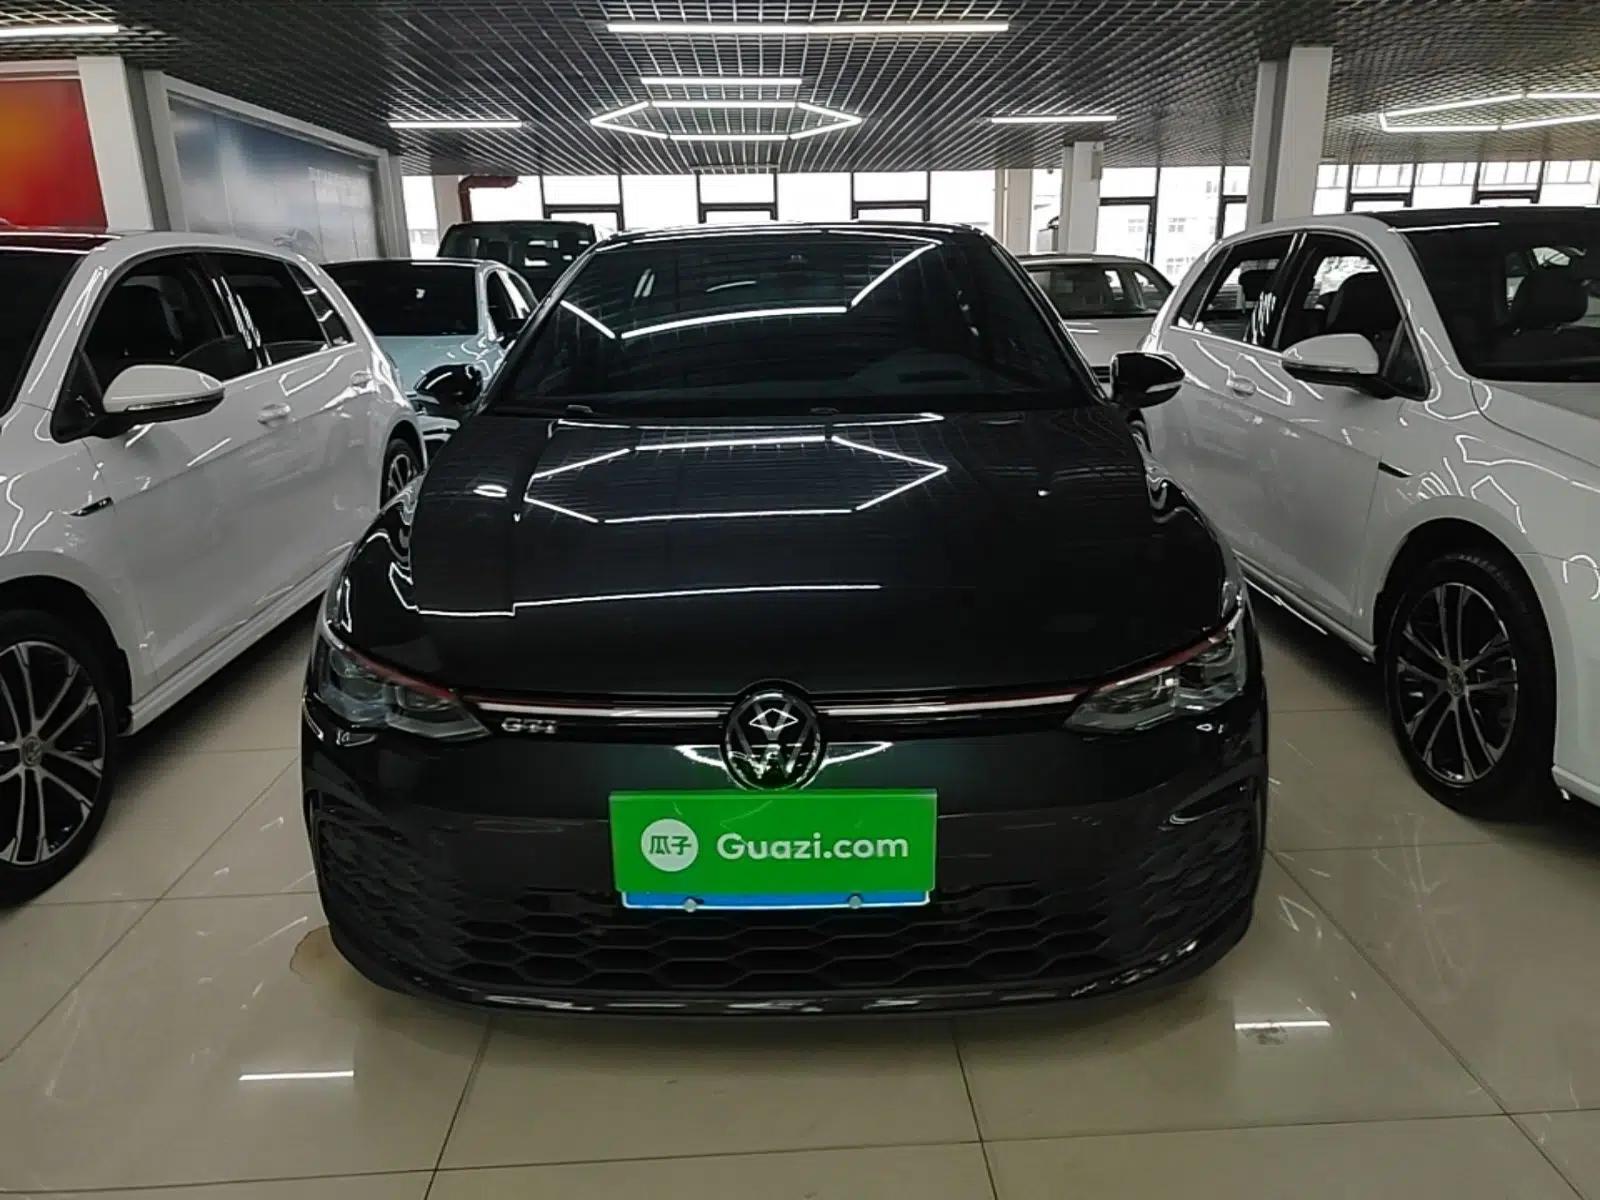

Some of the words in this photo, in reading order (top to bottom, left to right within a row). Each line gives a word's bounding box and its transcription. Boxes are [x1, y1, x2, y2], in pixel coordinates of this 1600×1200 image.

[501, 717, 556, 734] GTI
[649, 835, 692, 855] 瓜子
[716, 832, 909, 860] Guazi.com
